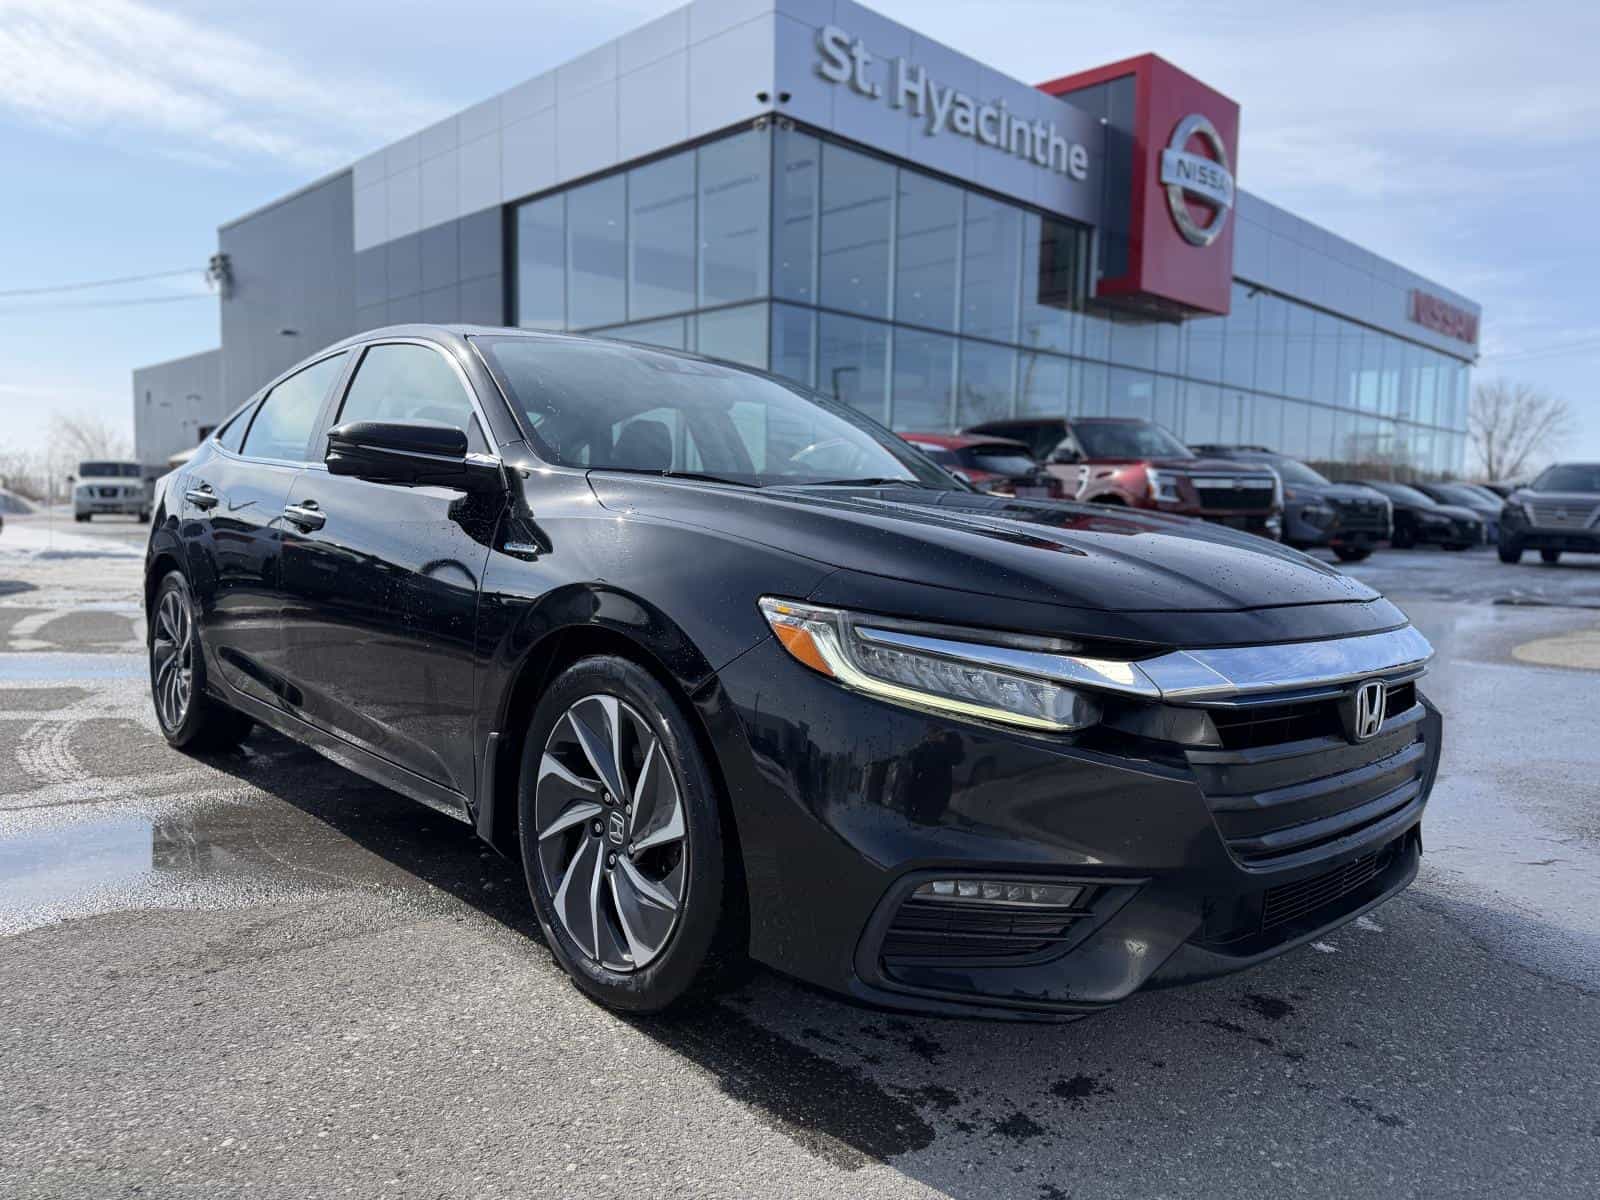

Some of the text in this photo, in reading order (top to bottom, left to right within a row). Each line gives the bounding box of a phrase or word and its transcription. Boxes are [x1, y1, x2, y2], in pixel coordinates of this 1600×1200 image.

[817, 25, 1090, 181] St. Hyacinthe
[1175, 157, 1232, 197] NISSA
